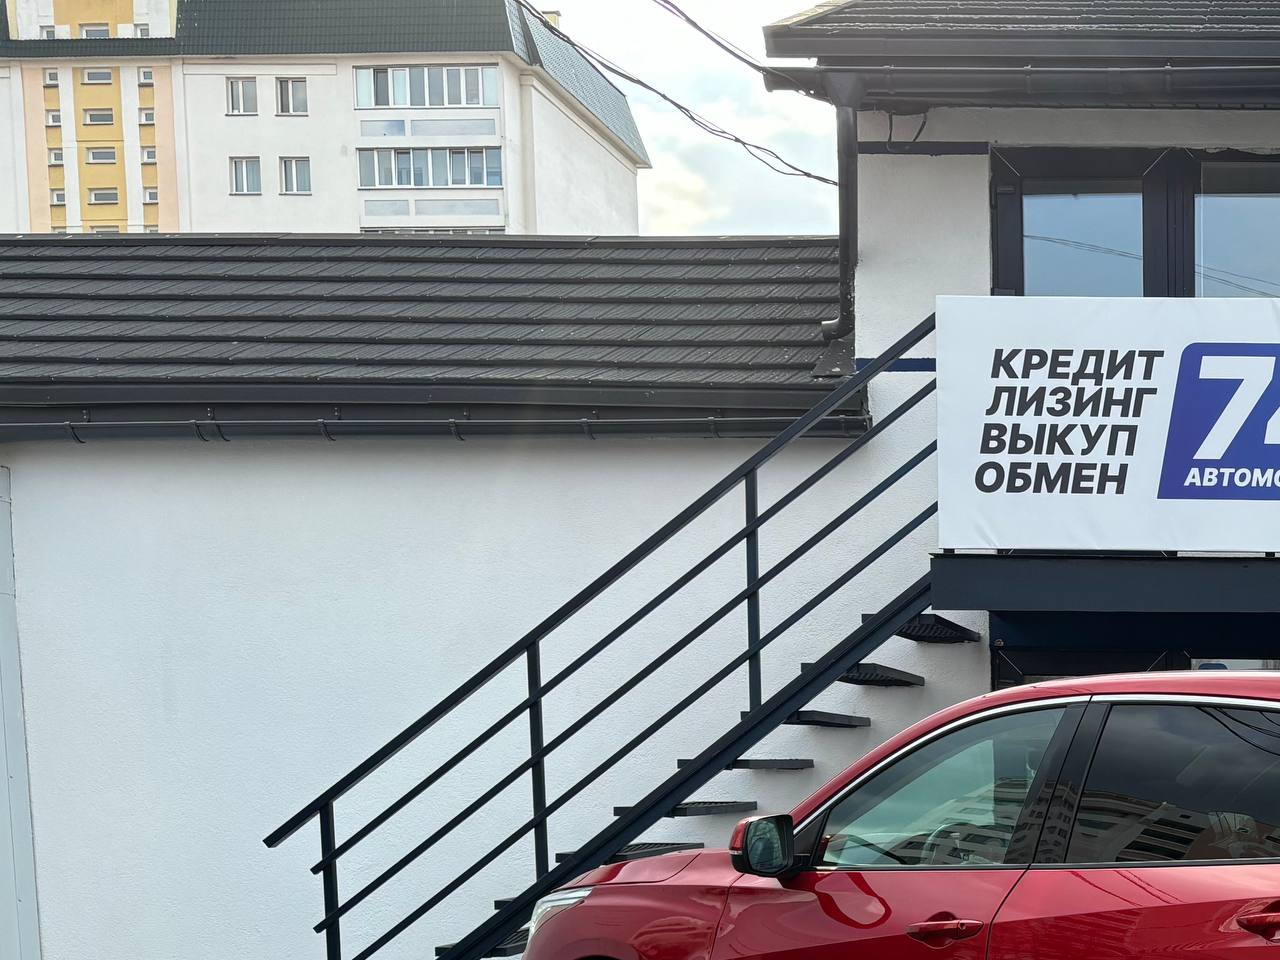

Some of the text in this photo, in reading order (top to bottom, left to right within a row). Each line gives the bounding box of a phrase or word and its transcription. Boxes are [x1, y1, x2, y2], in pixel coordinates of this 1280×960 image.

[990, 348, 1165, 387] КРЕДИТ
[985, 385, 1158, 418] ЛИЗИНГ
[979, 422, 1139, 457] ВЫКУП
[974, 461, 1129, 495] ОБМЕН
